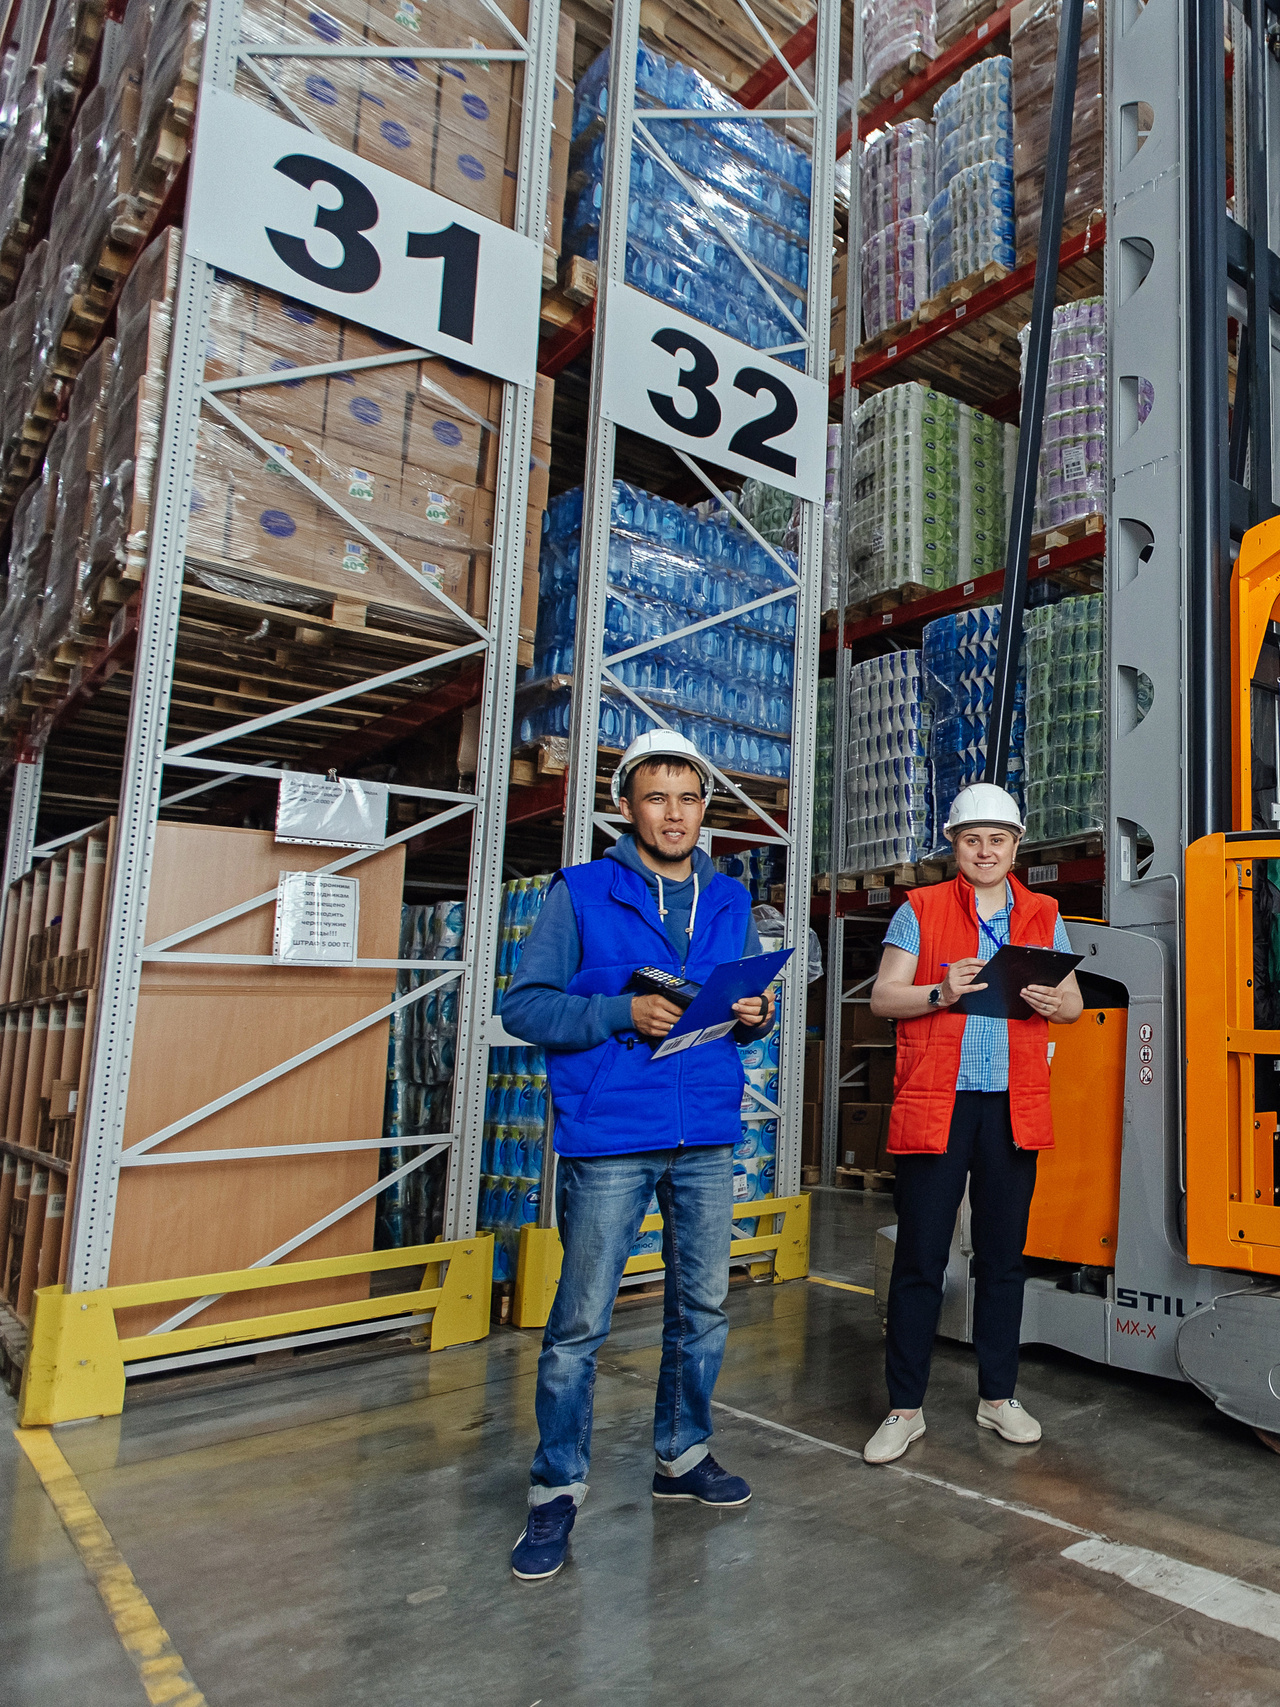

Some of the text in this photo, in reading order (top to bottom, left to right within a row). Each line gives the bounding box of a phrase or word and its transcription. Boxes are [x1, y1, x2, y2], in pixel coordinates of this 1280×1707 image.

[264, 153, 481, 345] 31
[646, 327, 799, 478] 32
[305, 881, 350, 889] осоронним
[1117, 1287, 1203, 1317] STIL
[1116, 1318, 1156, 1340] MX-X
